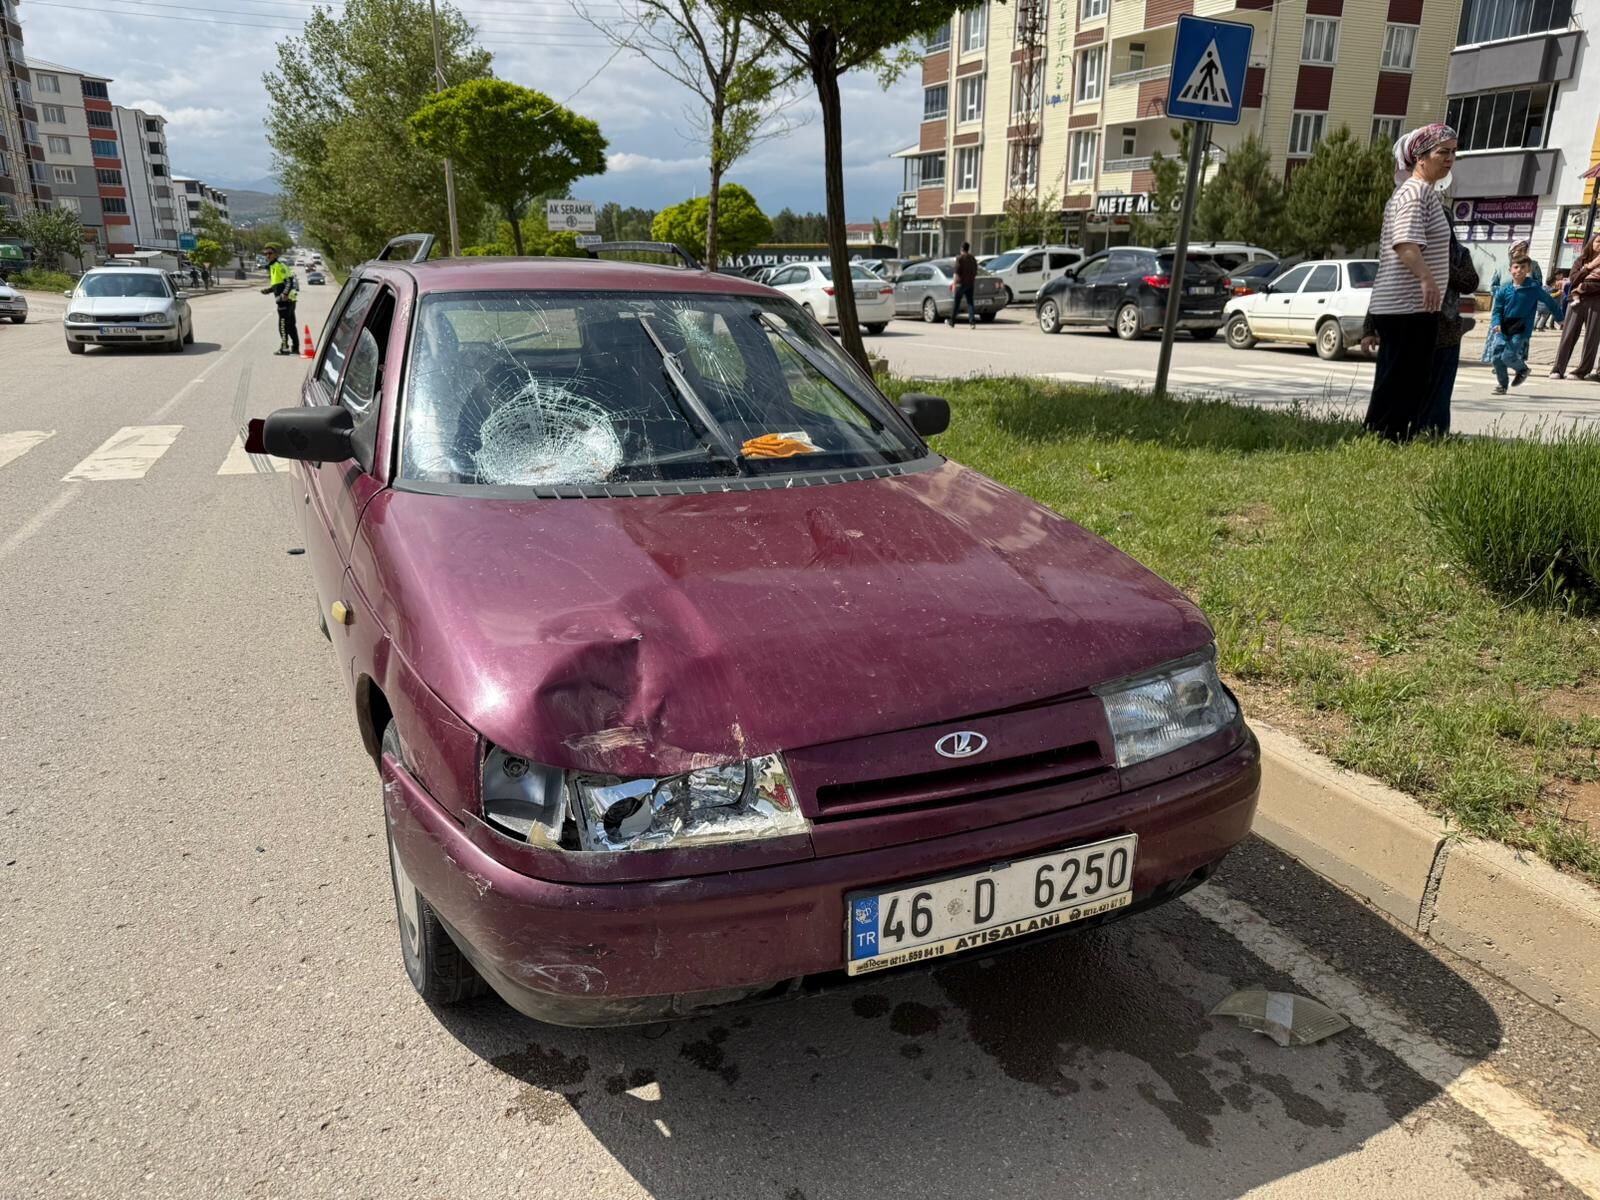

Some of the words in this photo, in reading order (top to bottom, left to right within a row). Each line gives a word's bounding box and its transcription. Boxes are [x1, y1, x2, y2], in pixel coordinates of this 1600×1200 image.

[549, 204, 559, 215] AK
[1097, 196, 1134, 213] METE
[747, 255, 778, 266] YAPI
[882, 891, 933, 942] 46
[973, 878, 996, 925] D
[1033, 847, 1128, 909] 6250
[856, 931, 876, 947] TR
